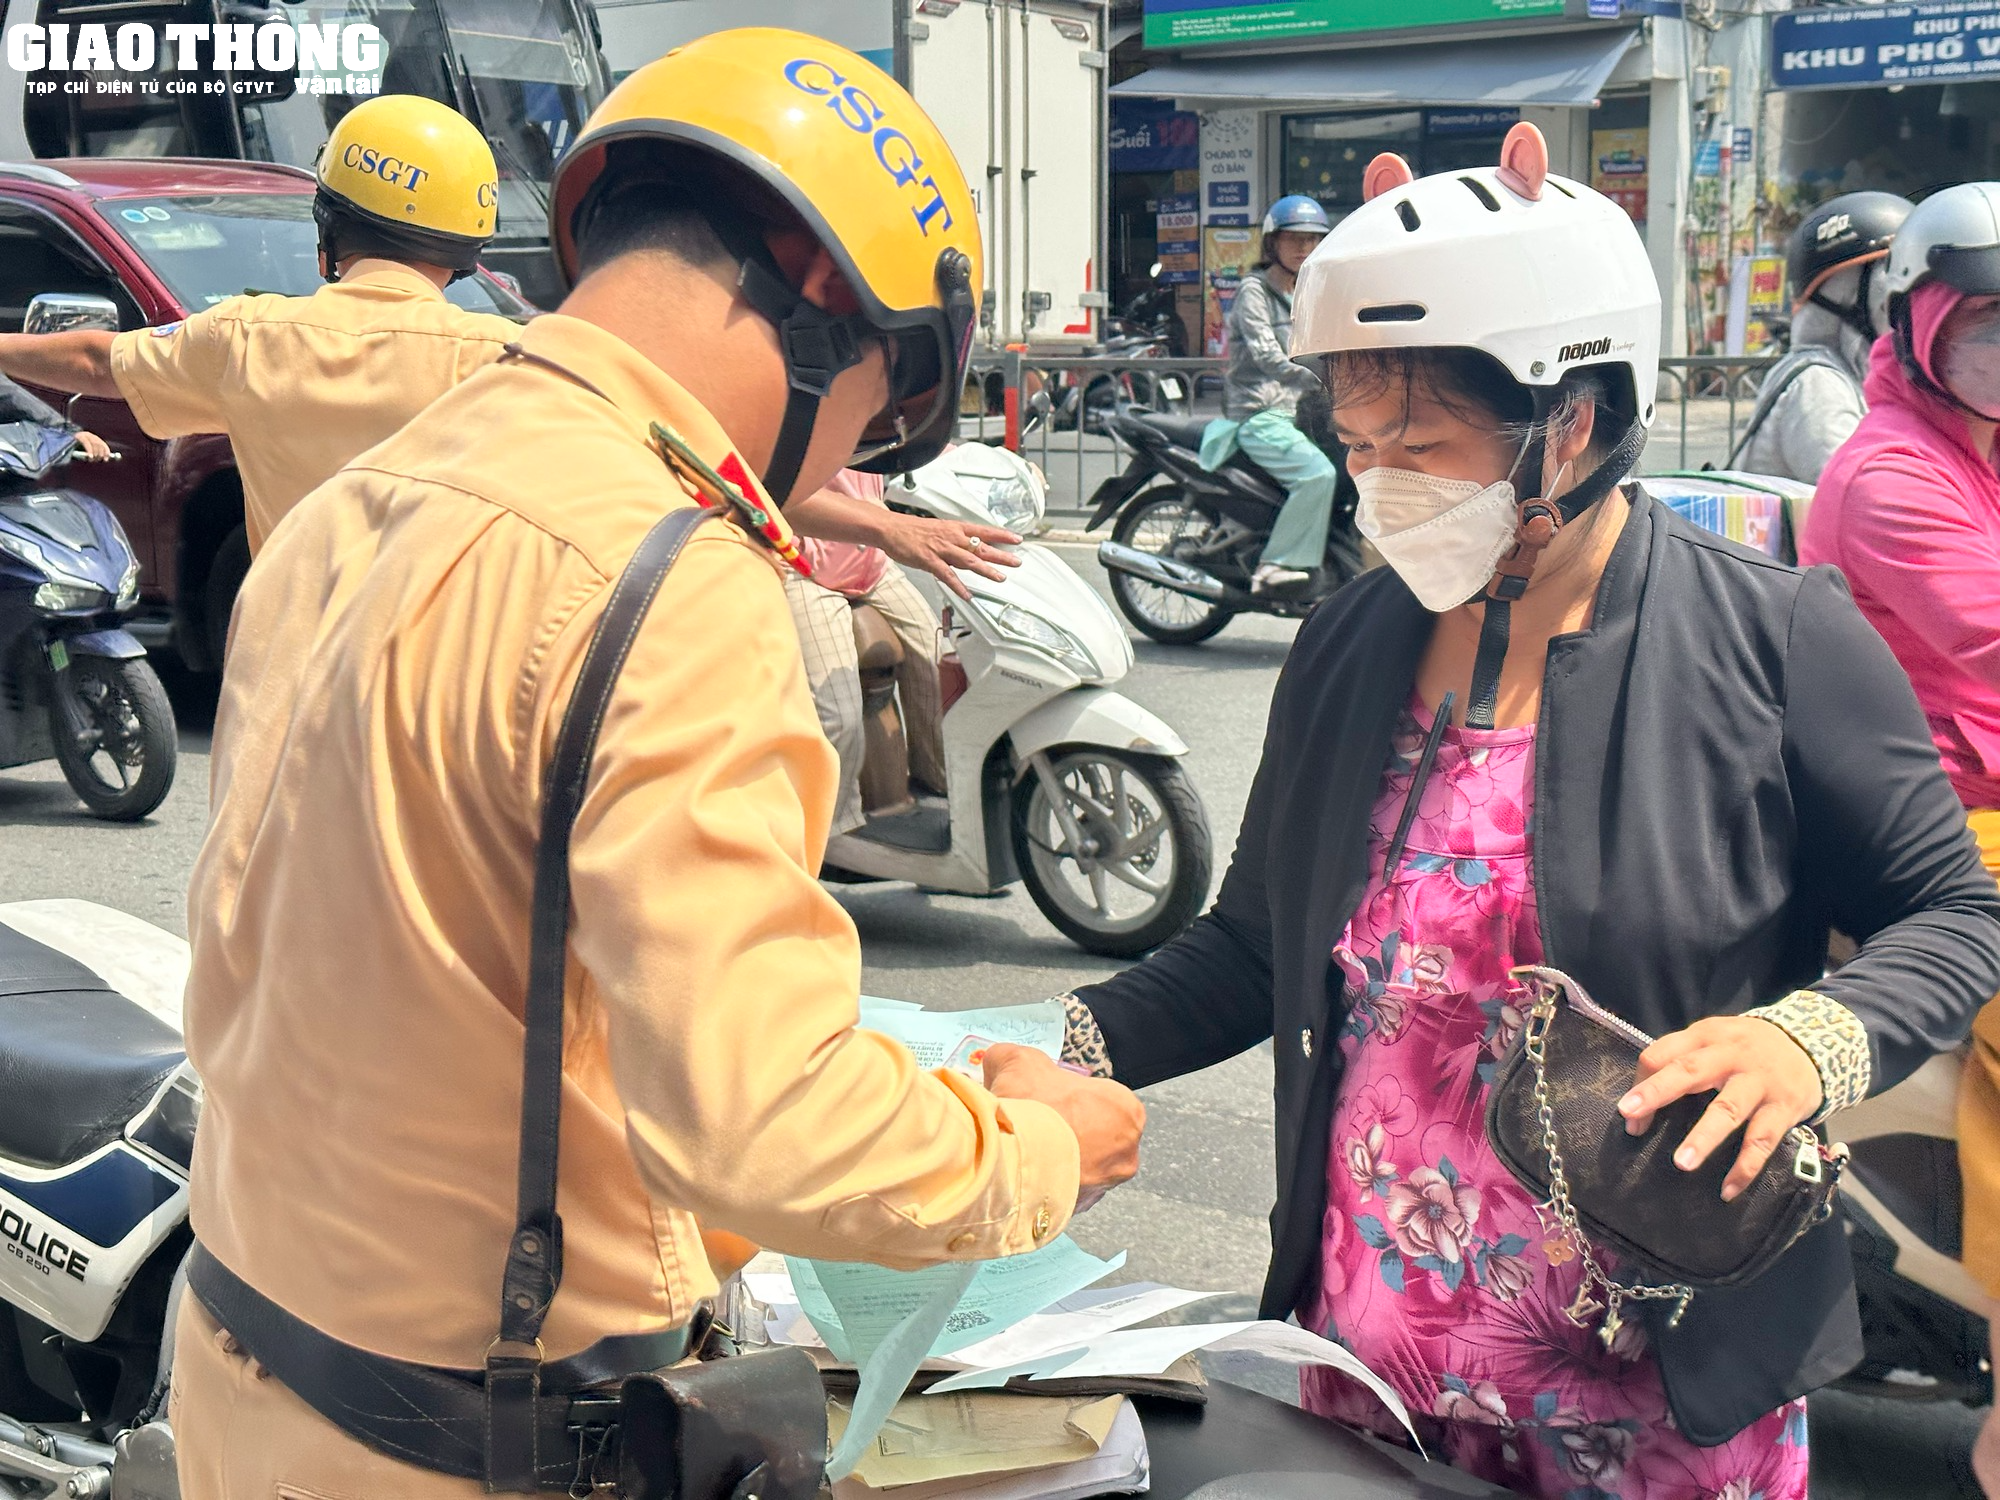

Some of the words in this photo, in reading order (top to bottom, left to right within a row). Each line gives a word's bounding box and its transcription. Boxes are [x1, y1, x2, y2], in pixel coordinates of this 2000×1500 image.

[1913, 18, 1959, 36] KHU
[1964, 14, 2000, 31] PH
[1782, 46, 1865, 70] KHU
[1878, 33, 1964, 64] PHỐ
[1977, 36, 2000, 56] V
[784, 59, 953, 238] CSGT
[1109, 124, 1151, 149] Suối
[1204, 148, 1236, 160] CHÚNG
[1239, 148, 1253, 159] TÔI
[343, 143, 429, 193] CSGT
[1212, 162, 1225, 174] CÓ
[1226, 162, 1246, 173] BÁN
[1558, 336, 1612, 362] napoli
[1001, 669, 1042, 689] HONDA
[0, 1203, 90, 1282] OLICE
[7, 1242, 25, 1260] CB
[26, 1255, 50, 1276] 250
